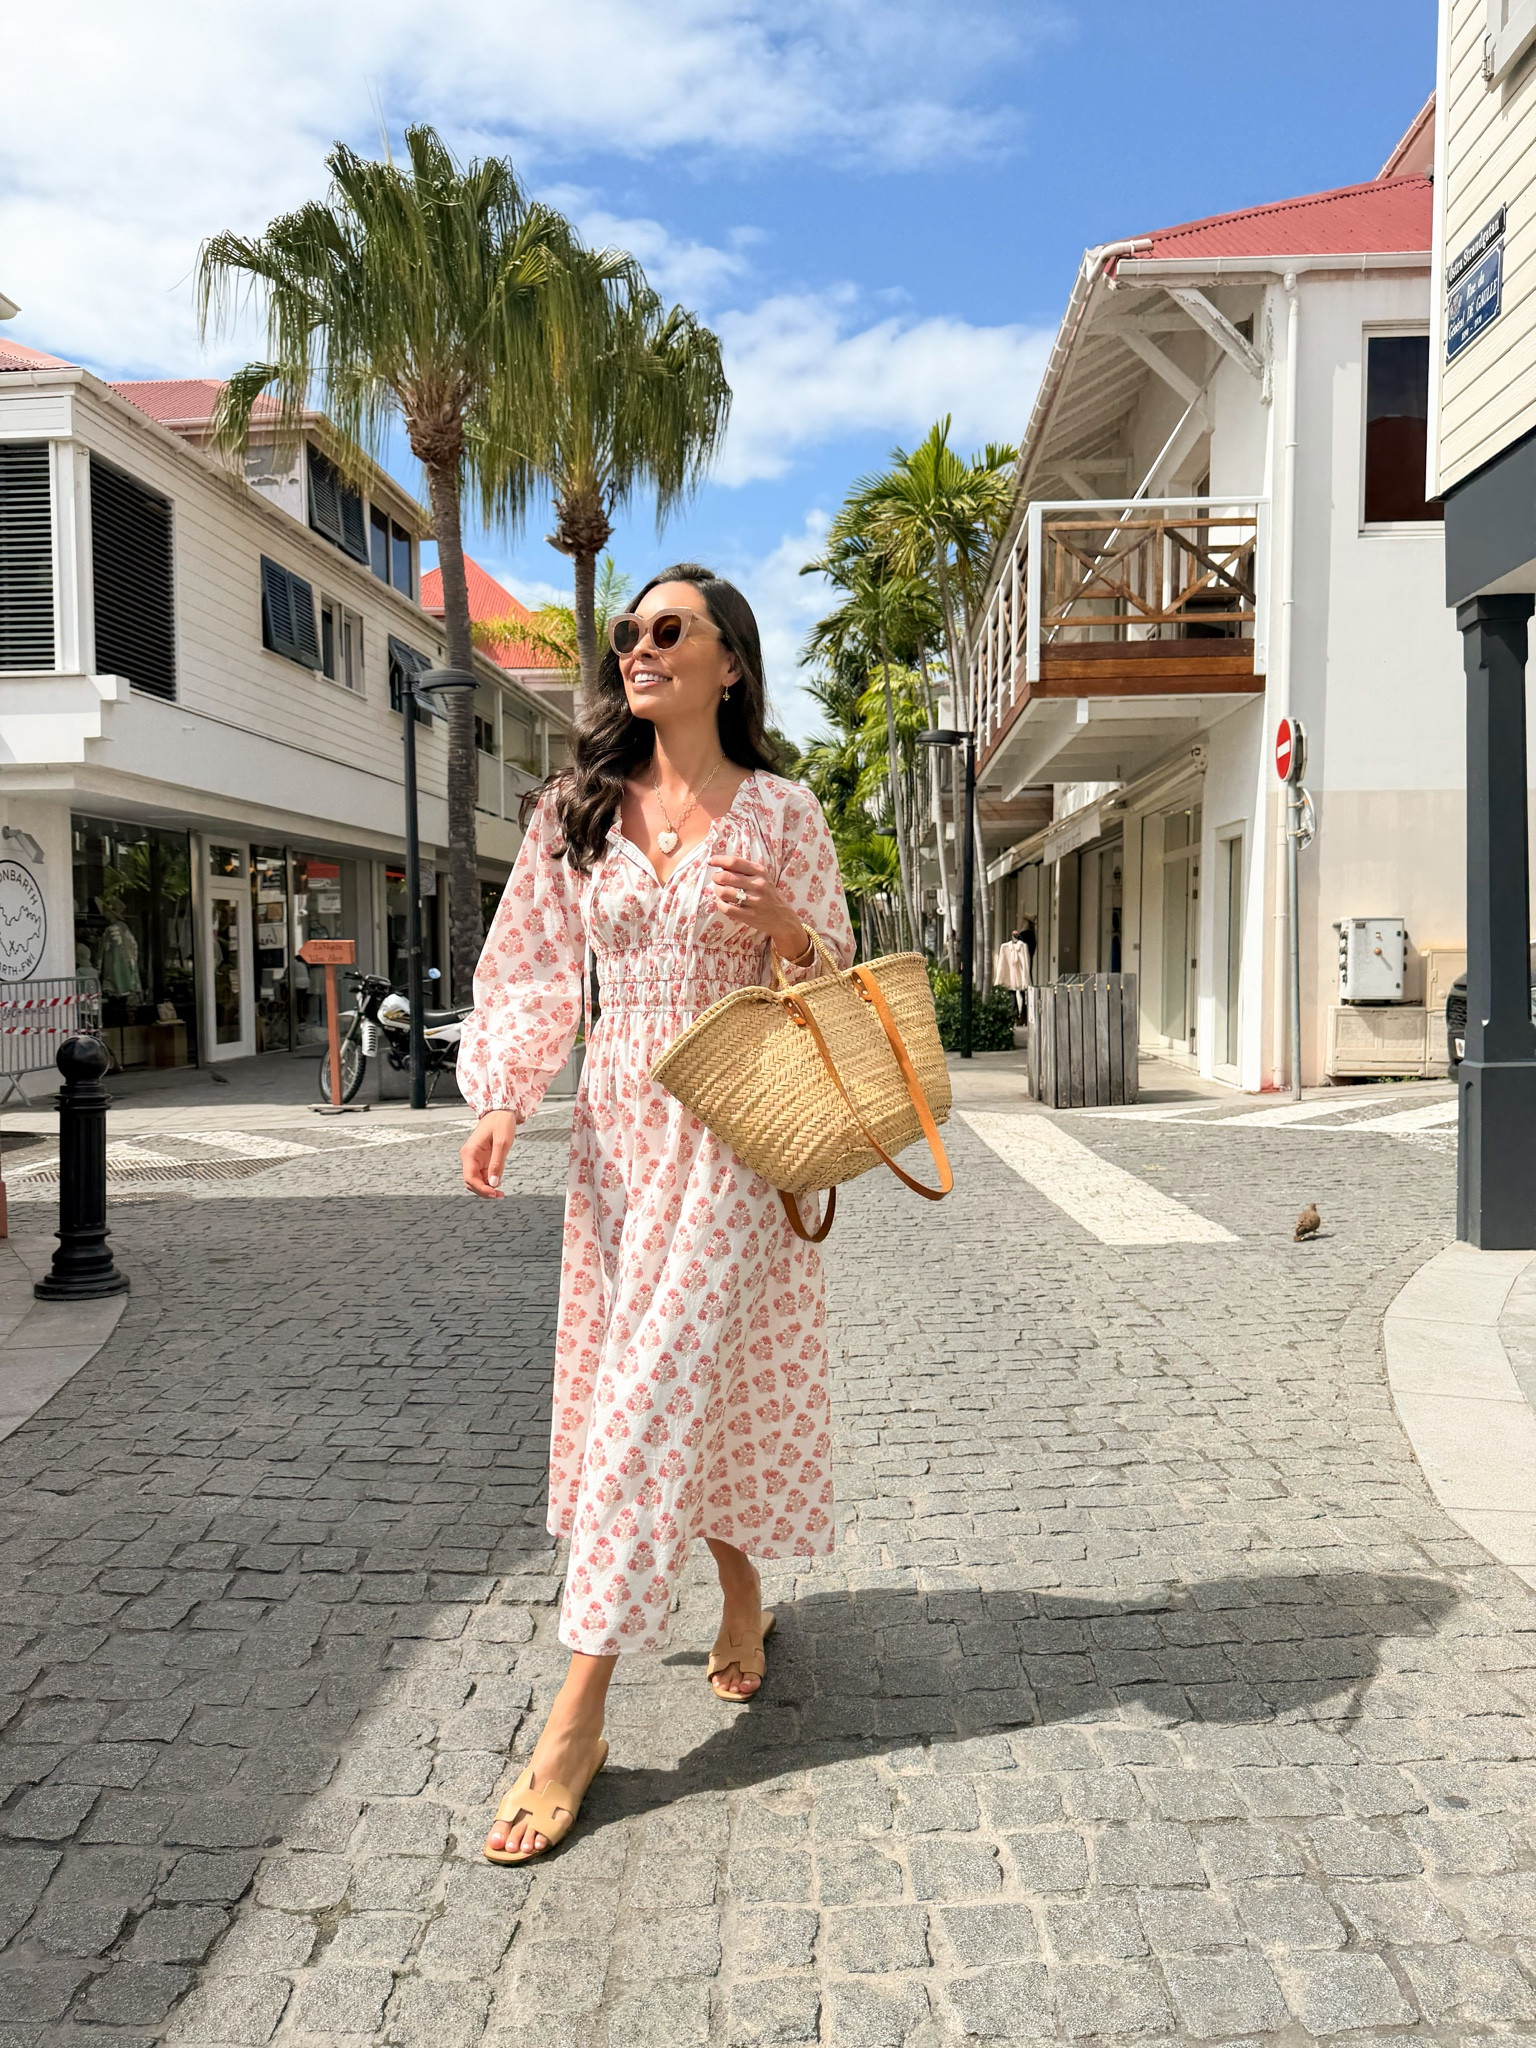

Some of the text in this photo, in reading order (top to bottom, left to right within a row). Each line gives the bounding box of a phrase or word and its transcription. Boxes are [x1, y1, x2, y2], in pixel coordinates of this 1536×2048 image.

[1463, 219, 1500, 266] Strandgatan
[1466, 269, 1485, 301] Rue du
[1448, 277, 1498, 340] Général DE GAULLE
[0, 952, 36, 976] RTH-FWI
